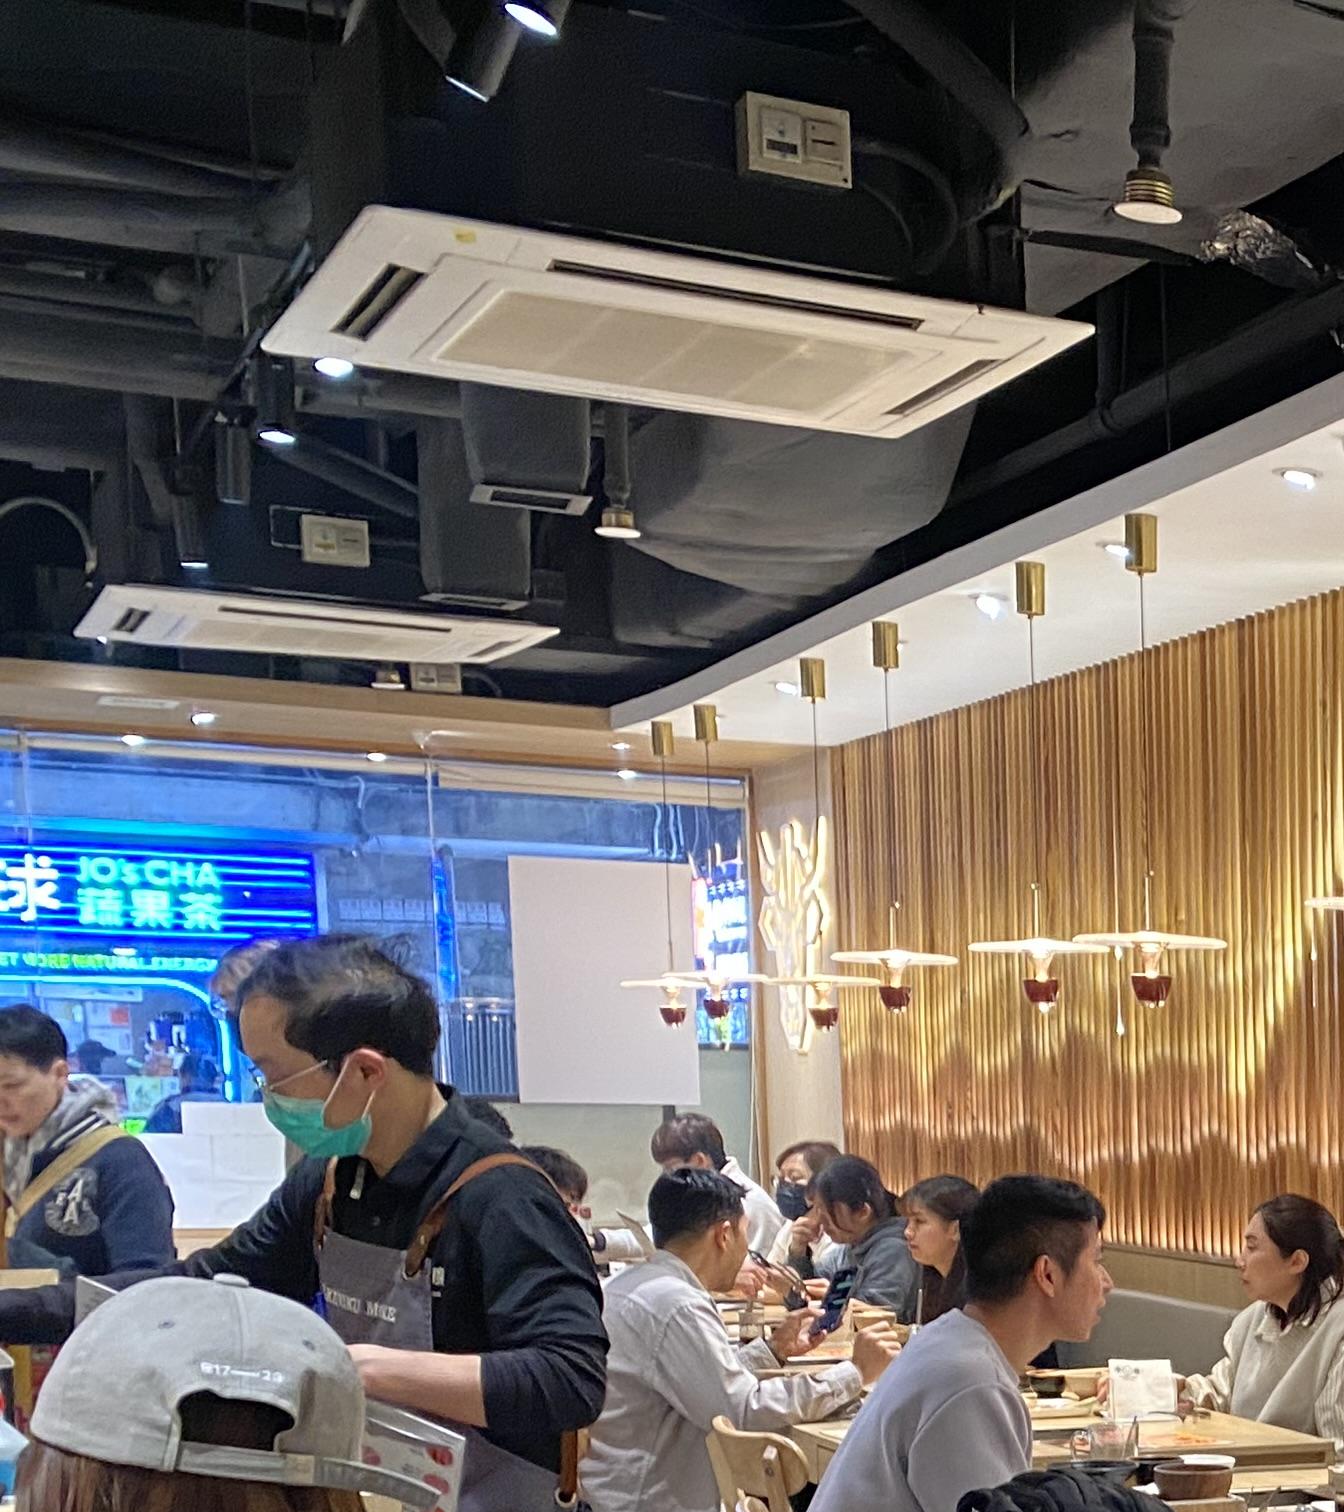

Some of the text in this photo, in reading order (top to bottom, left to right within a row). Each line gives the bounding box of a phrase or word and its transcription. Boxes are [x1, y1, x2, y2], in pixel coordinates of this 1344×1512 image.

[144, 860, 221, 888] CHA
[77, 887, 223, 930] 蔬果茶
